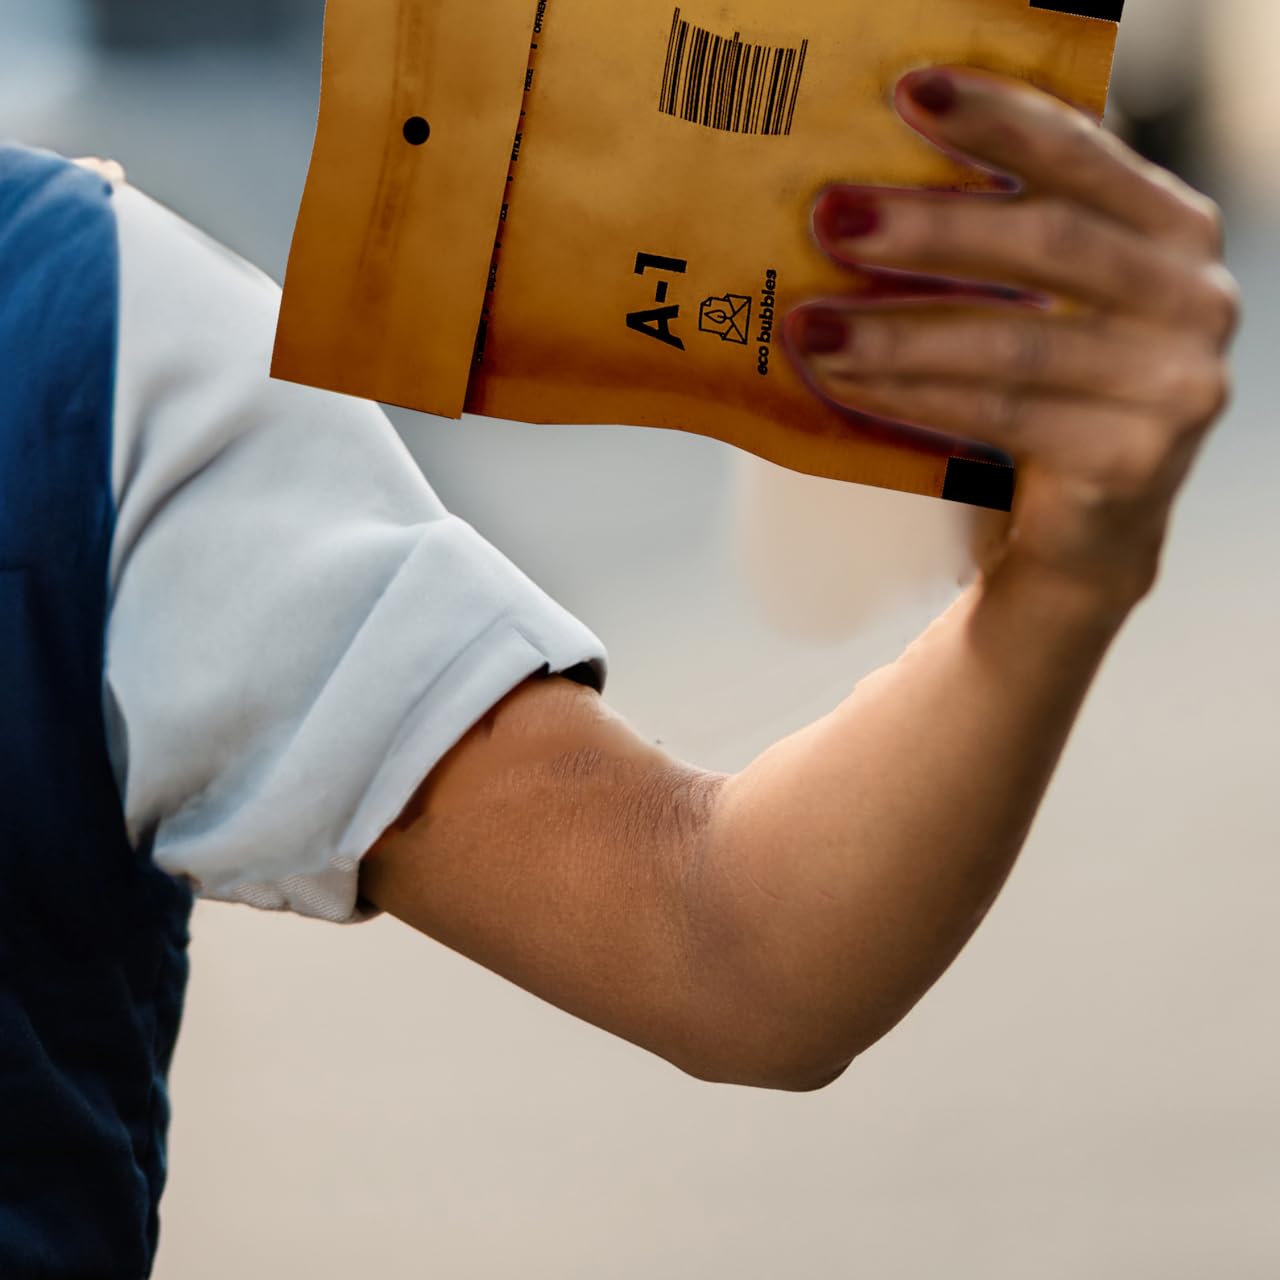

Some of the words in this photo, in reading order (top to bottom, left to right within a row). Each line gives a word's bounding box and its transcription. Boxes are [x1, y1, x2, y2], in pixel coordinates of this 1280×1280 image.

[626, 252, 687, 351] A-1
[757, 269, 776, 342] bubbles
[757, 346, 769, 375] eco
